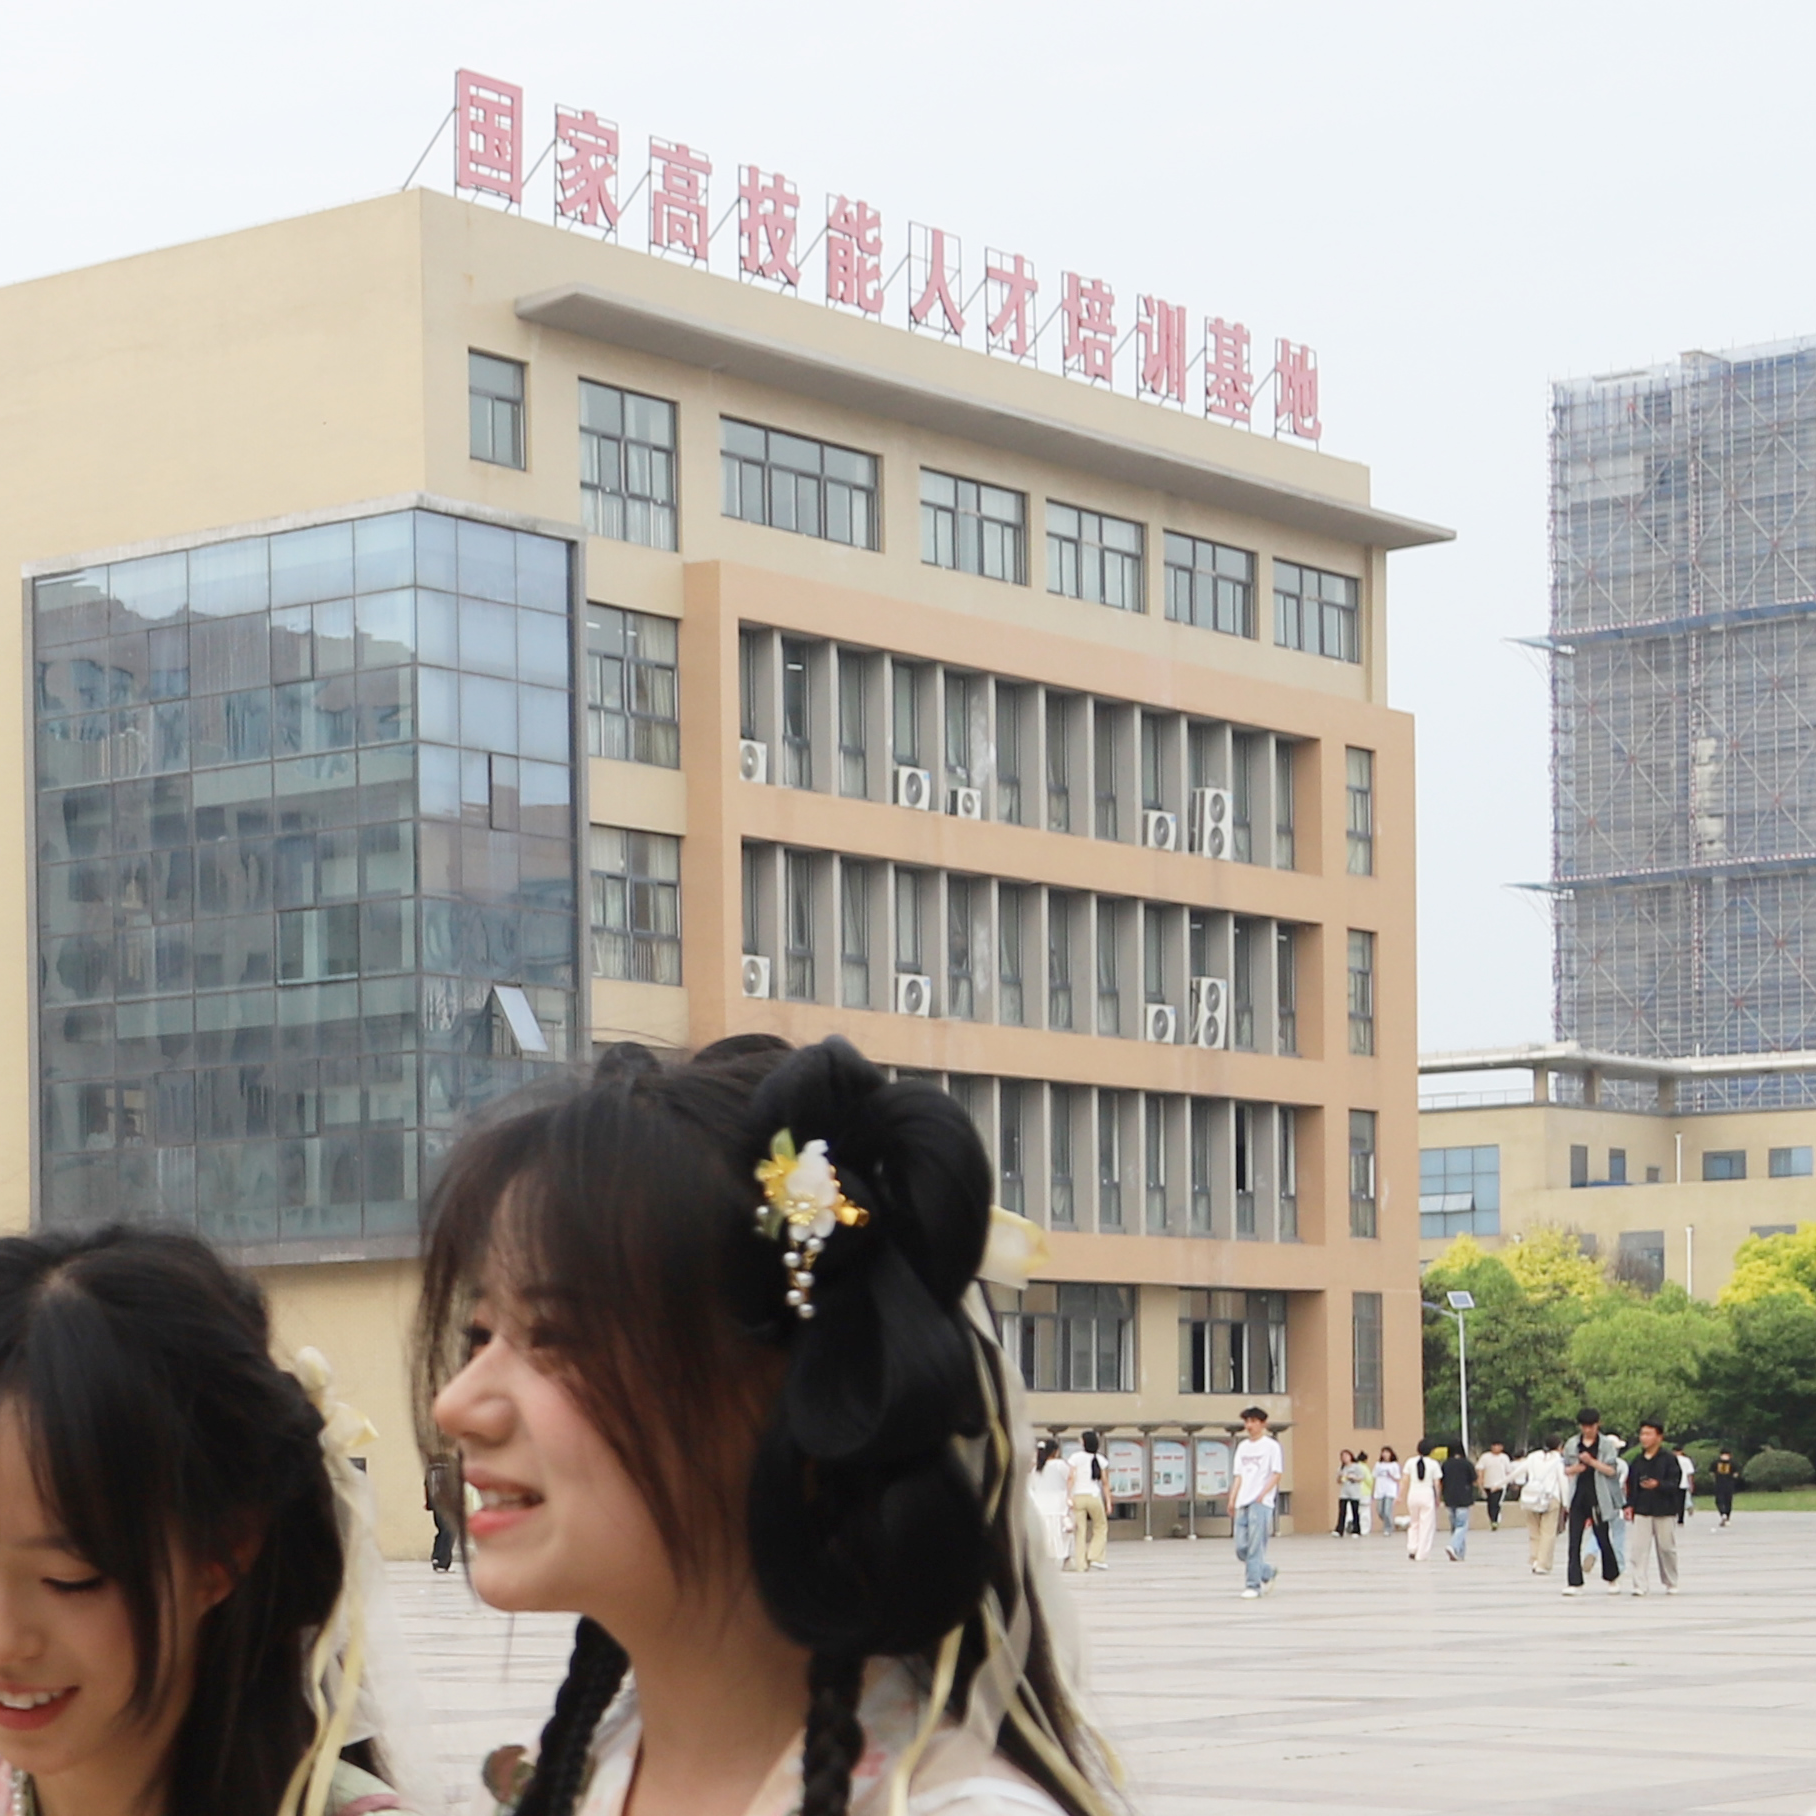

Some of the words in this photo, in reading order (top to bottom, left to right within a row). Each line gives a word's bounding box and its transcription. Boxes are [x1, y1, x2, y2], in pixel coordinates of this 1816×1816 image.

[456, 68, 1322, 440] 国家高技能人才培训基地
